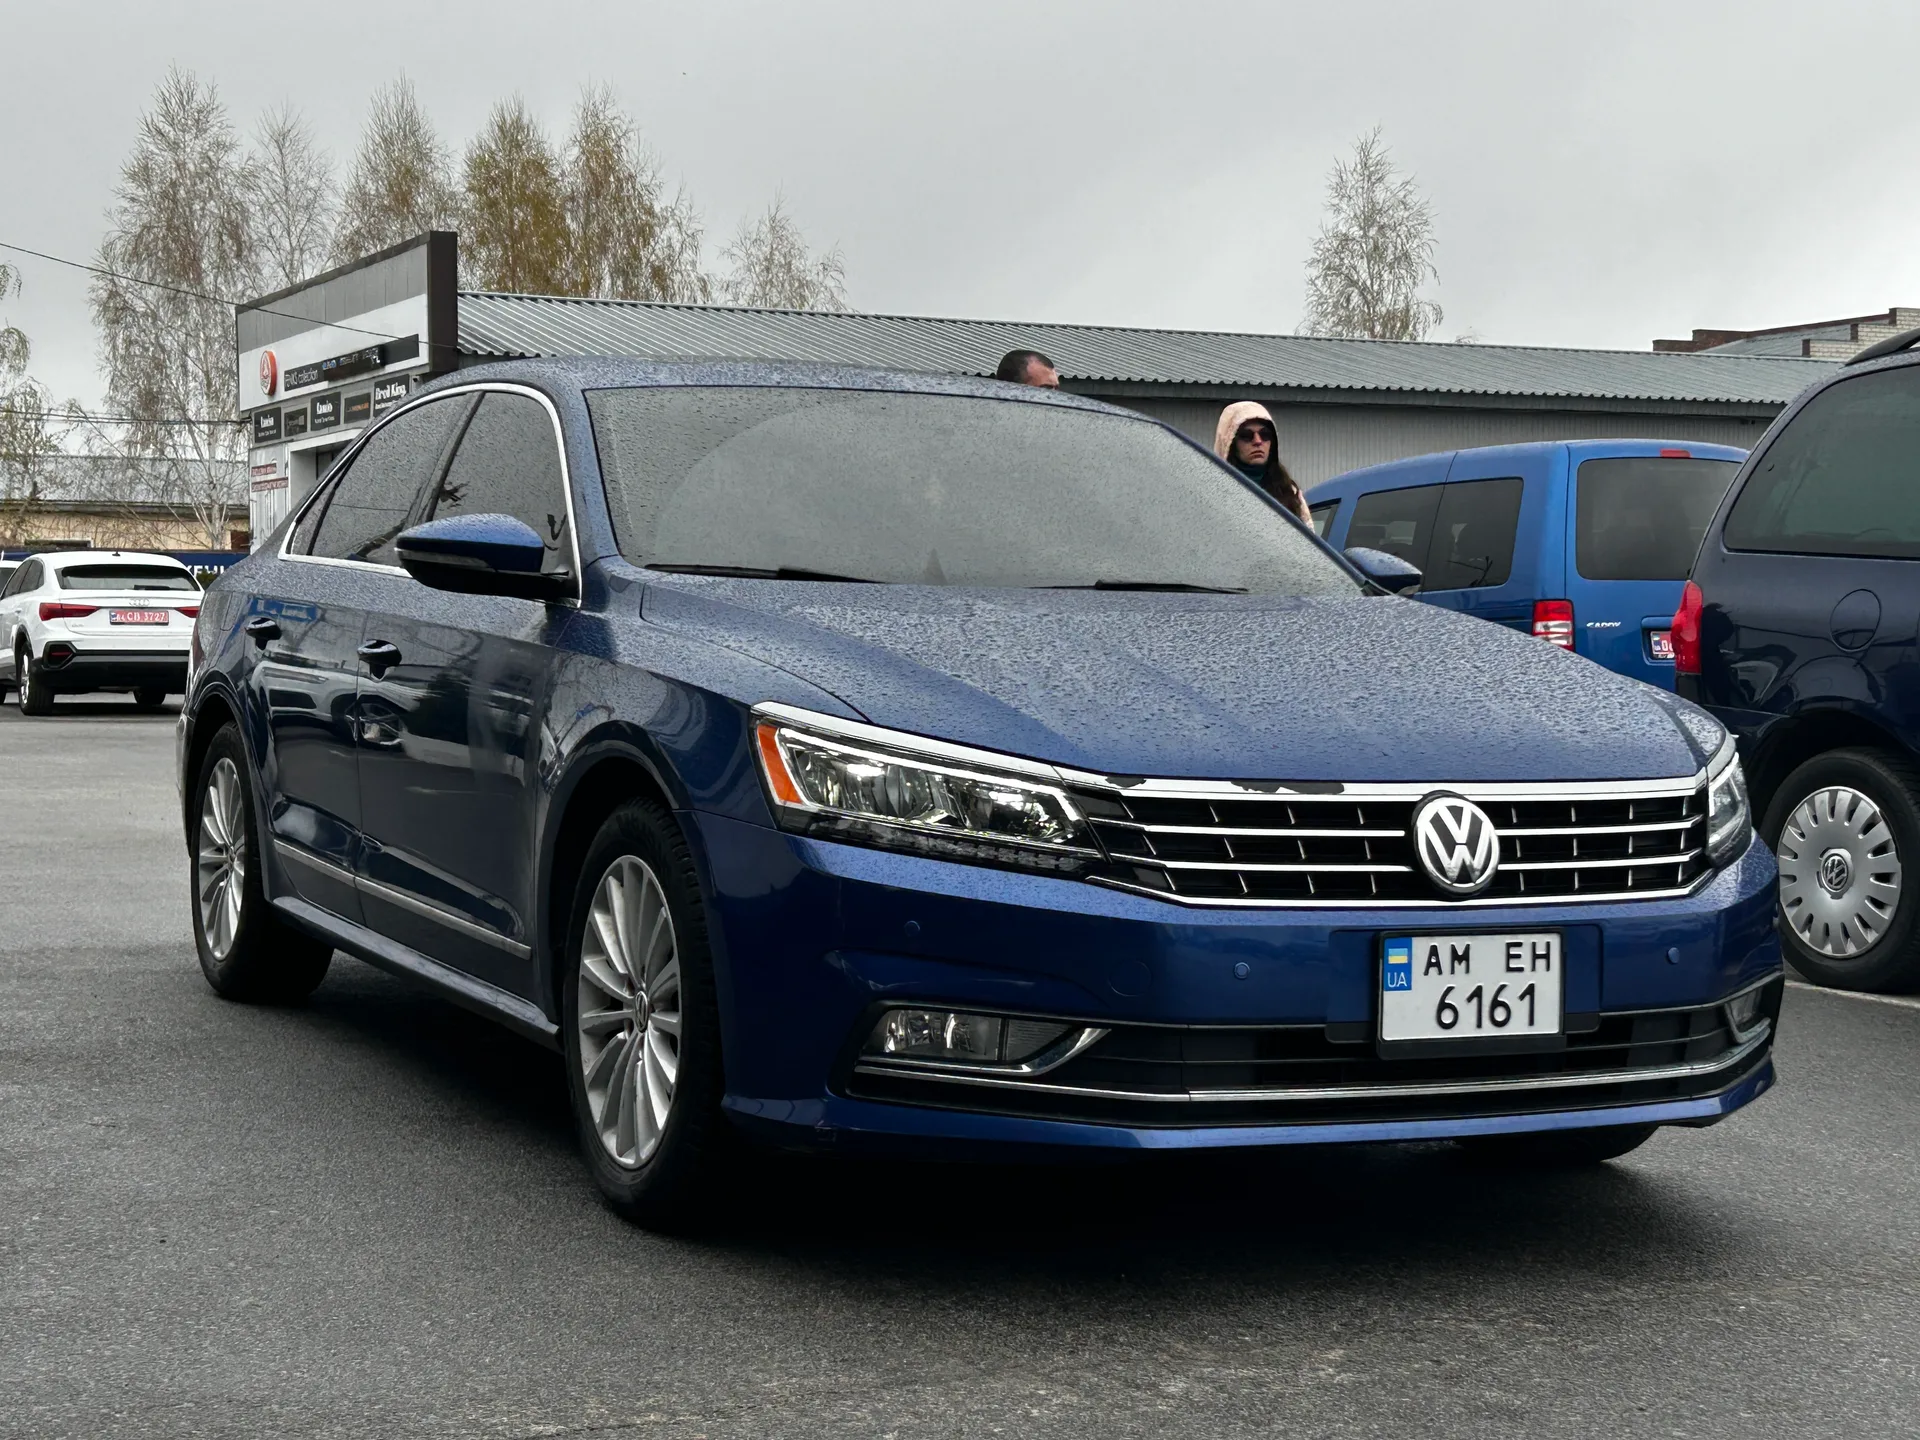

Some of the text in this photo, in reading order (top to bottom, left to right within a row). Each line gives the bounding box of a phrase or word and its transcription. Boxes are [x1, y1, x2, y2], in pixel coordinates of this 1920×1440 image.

[1423, 941, 1551, 977] AM EH
[1387, 972, 1408, 988] UA
[1436, 983, 1536, 1030] 6161
